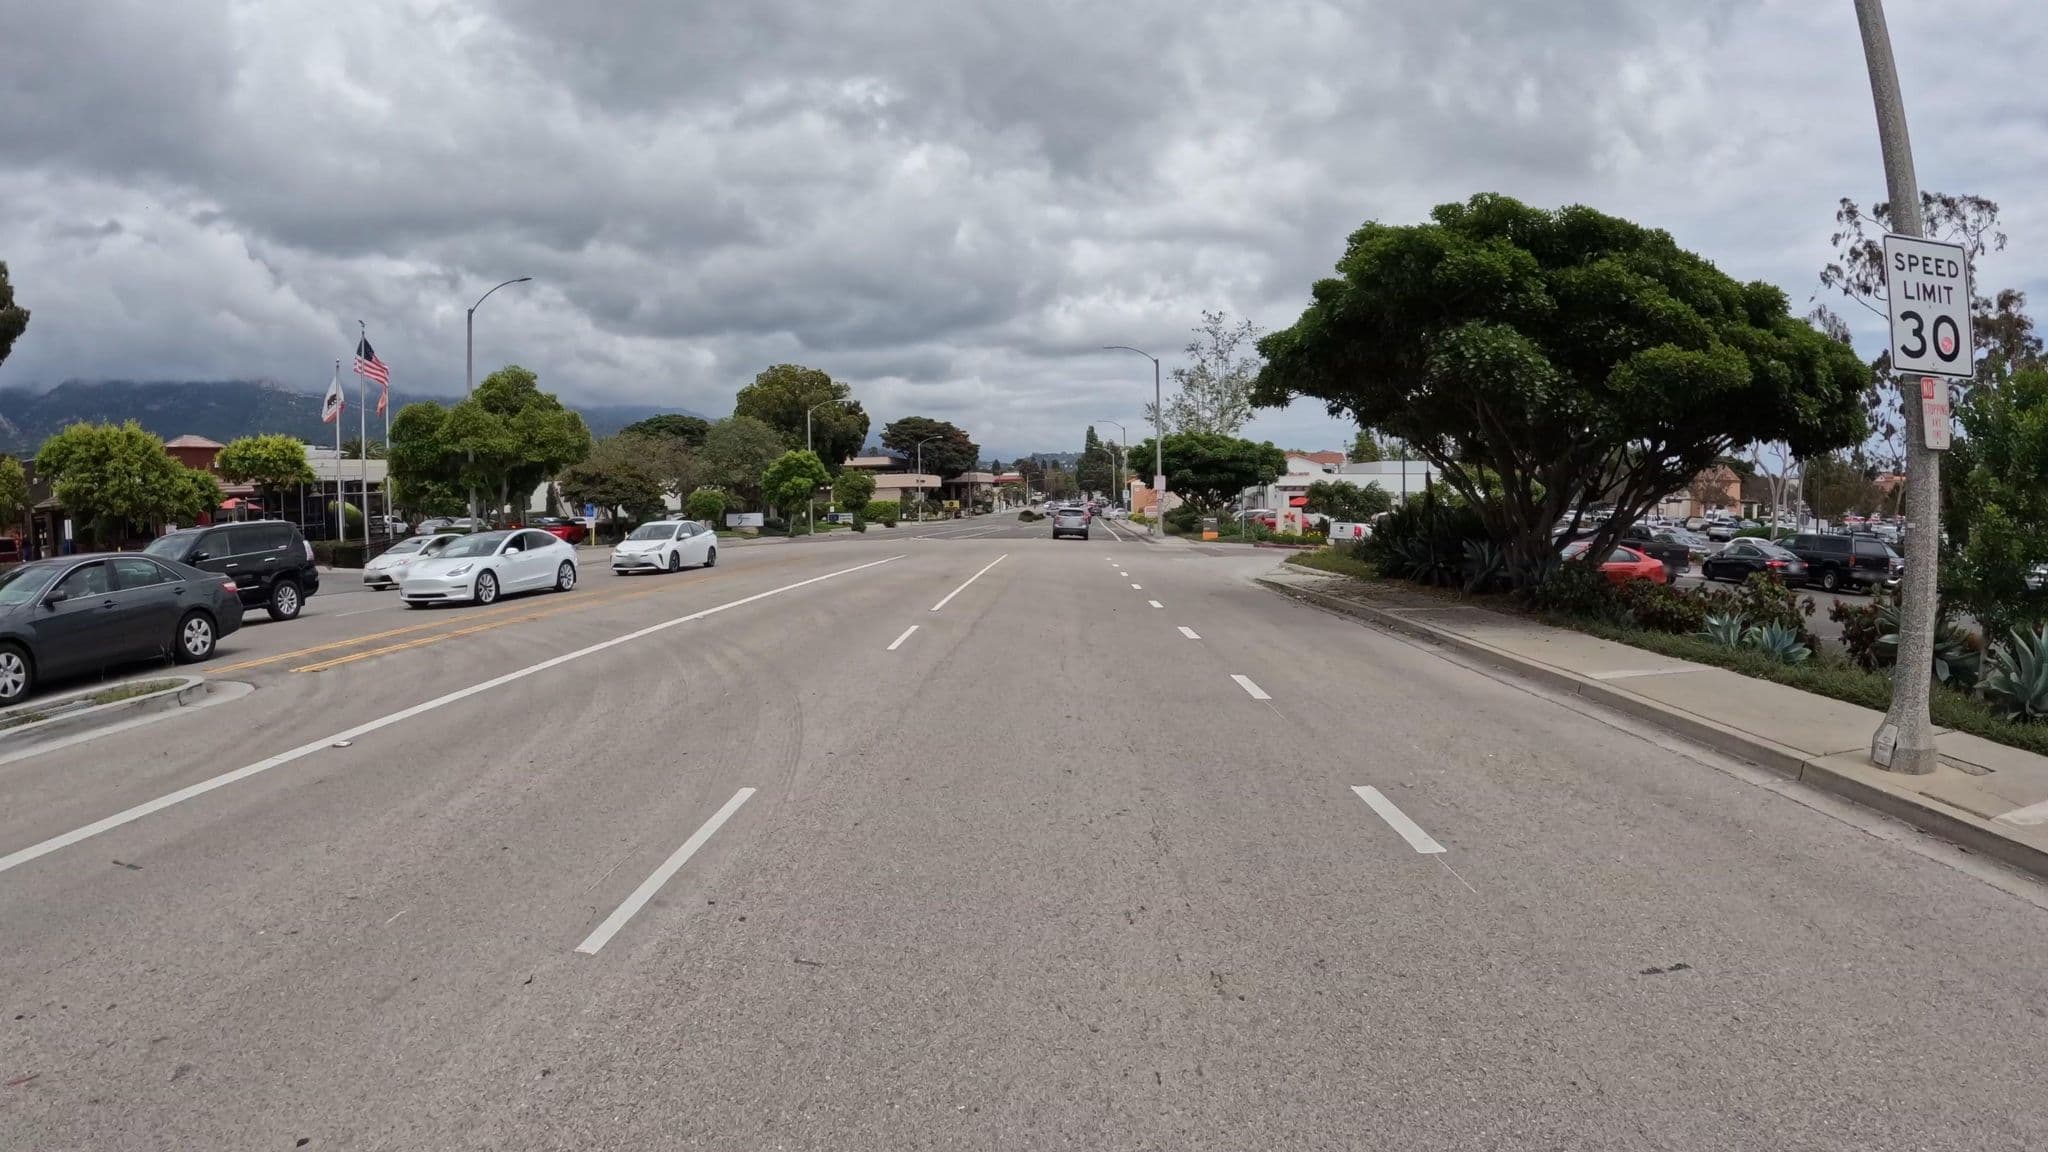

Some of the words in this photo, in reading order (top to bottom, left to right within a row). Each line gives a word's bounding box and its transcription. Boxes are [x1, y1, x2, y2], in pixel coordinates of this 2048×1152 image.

[1894, 252, 1959, 278] SPEED
[1903, 280, 1953, 305] LIMIT
[1900, 310, 1960, 362] 30
[1923, 380, 1934, 397] NO
